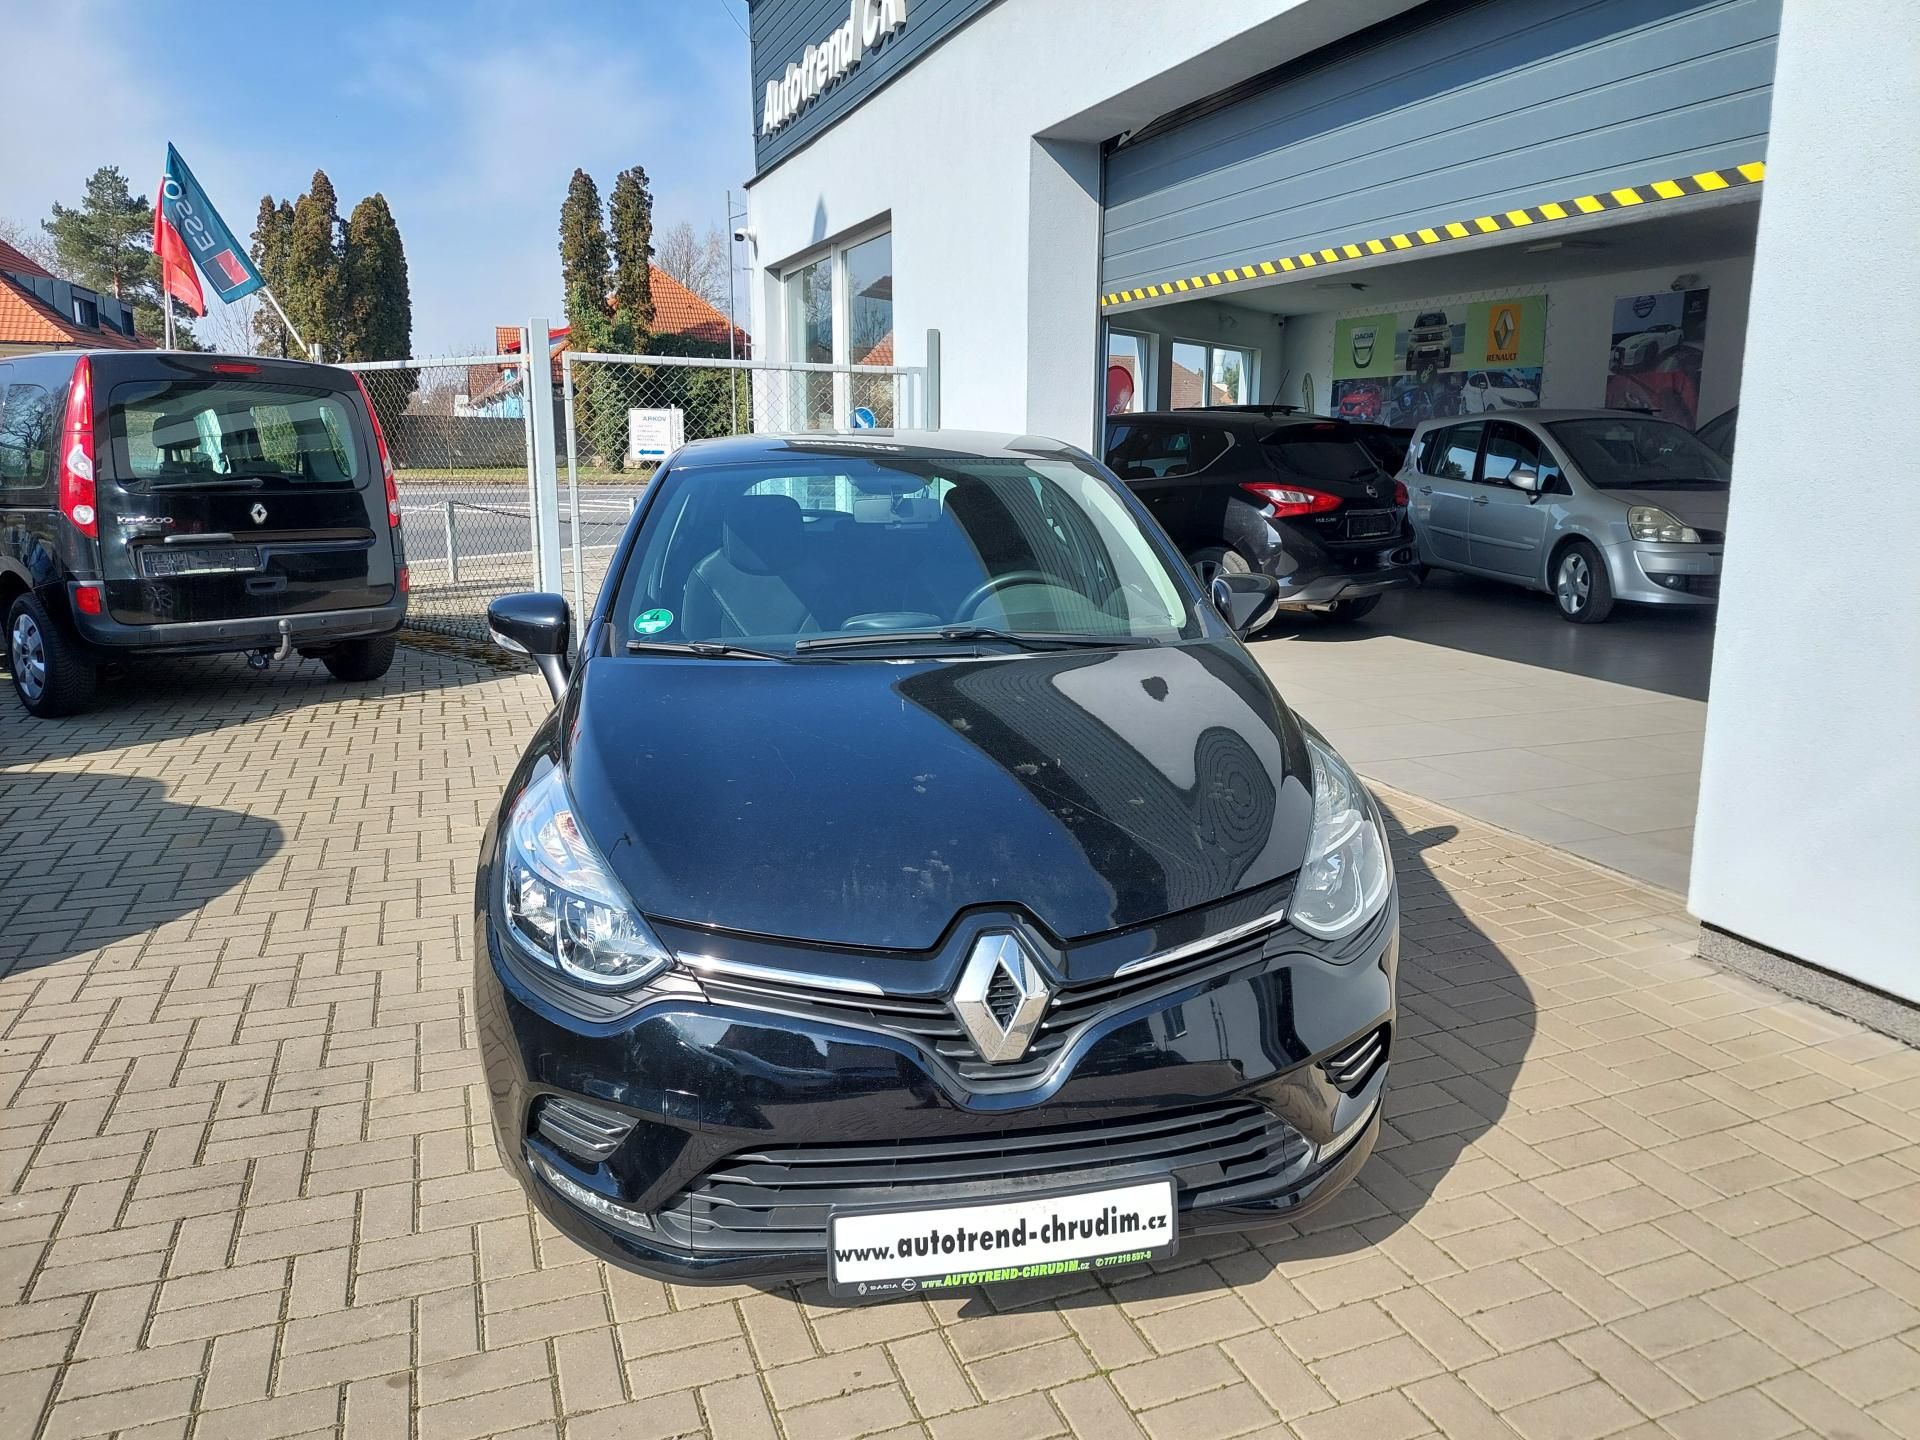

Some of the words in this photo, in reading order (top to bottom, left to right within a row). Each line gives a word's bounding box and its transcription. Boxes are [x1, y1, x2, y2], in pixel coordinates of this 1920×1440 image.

[763, 0, 861, 135] Autotrend
[1486, 352, 1517, 362] RENAULT
[650, 610, 660, 621] 4
[835, 1205, 1168, 1263] www.autotrend-chrudim.cz
